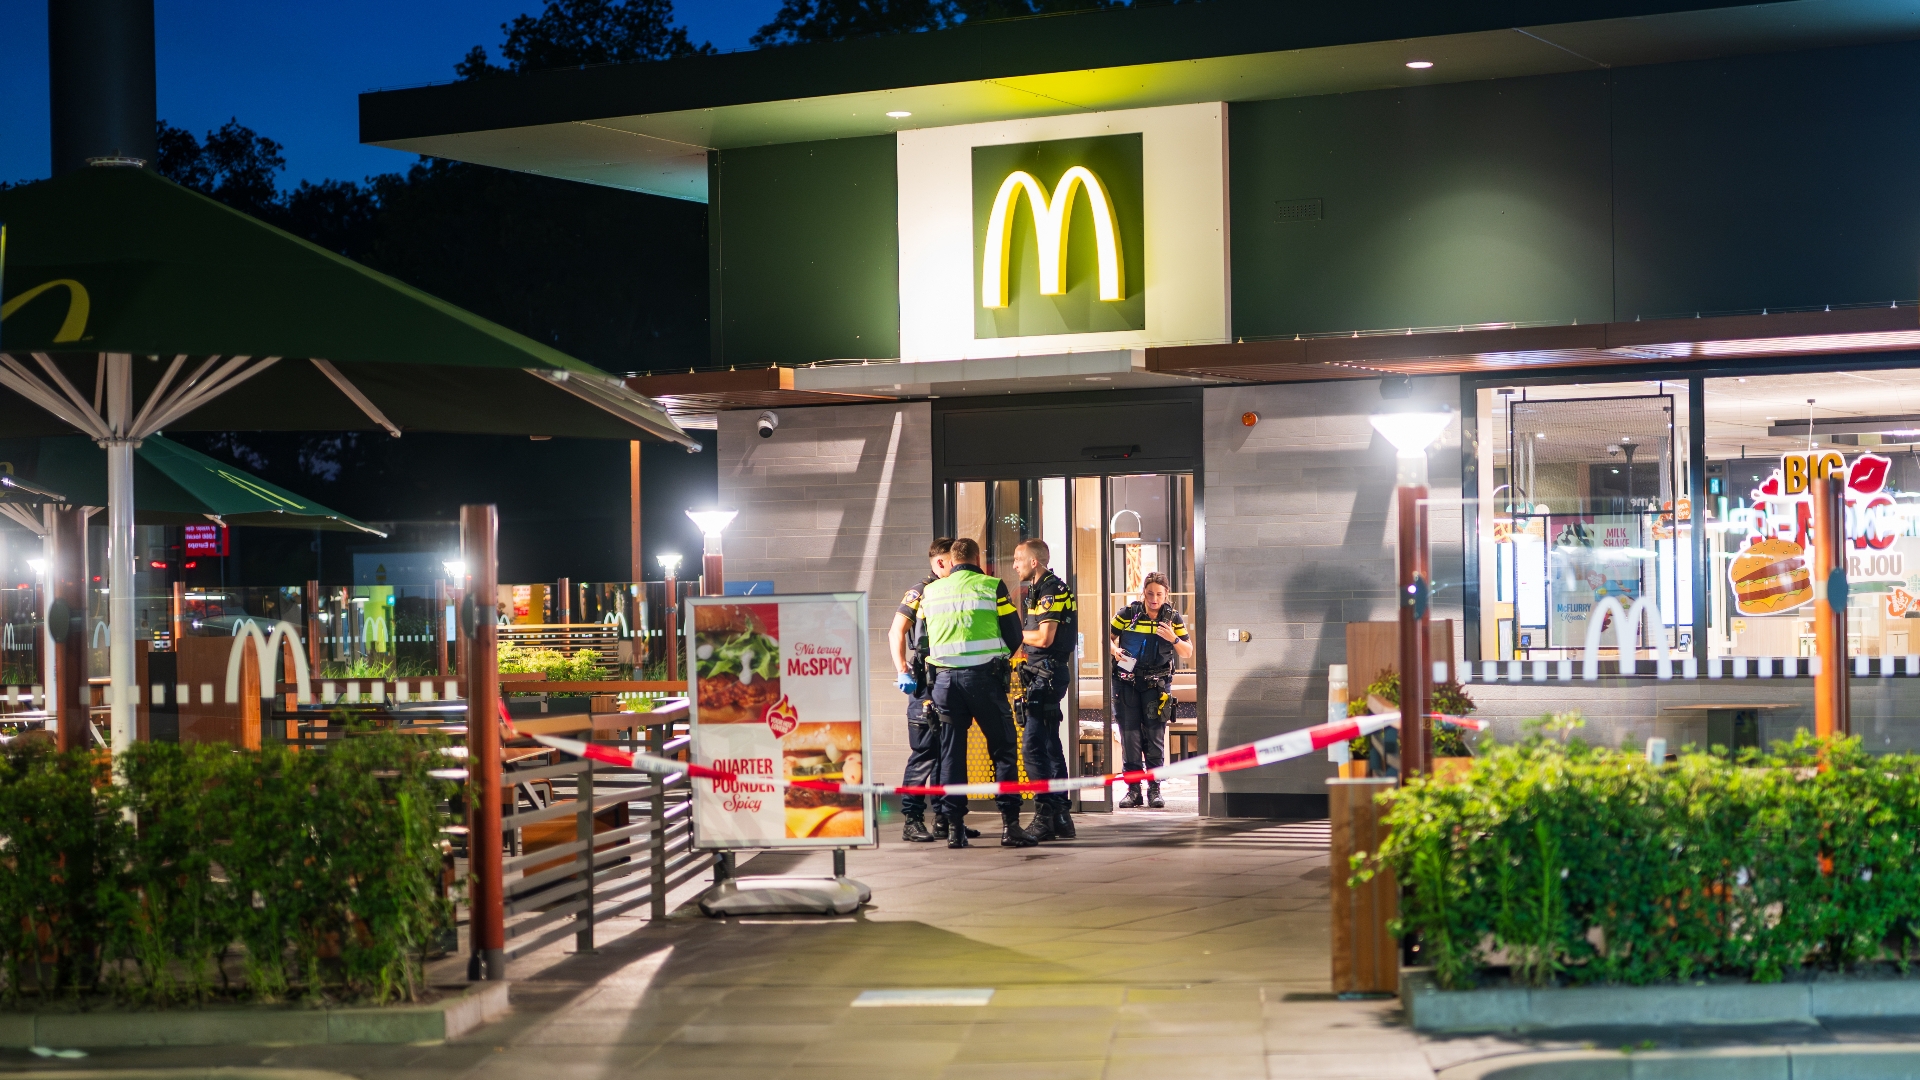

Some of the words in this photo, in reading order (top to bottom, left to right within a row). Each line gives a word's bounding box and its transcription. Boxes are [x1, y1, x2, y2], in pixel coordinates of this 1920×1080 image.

[982, 166, 1125, 308] M
[1785, 453, 1844, 496] BIG
[1606, 528, 1626, 538] MILK
[1603, 539, 1630, 548] SHAKE
[1864, 554, 1902, 577] JOU
[1557, 603, 1592, 613] McFLURRY
[794, 642, 815, 656] Nu
[816, 643, 842, 657] terug
[787, 656, 853, 677] McSPICY
[713, 758, 773, 776] QUARTER
[712, 776, 776, 794] POUNDER
[723, 794, 762, 813] Spicy
